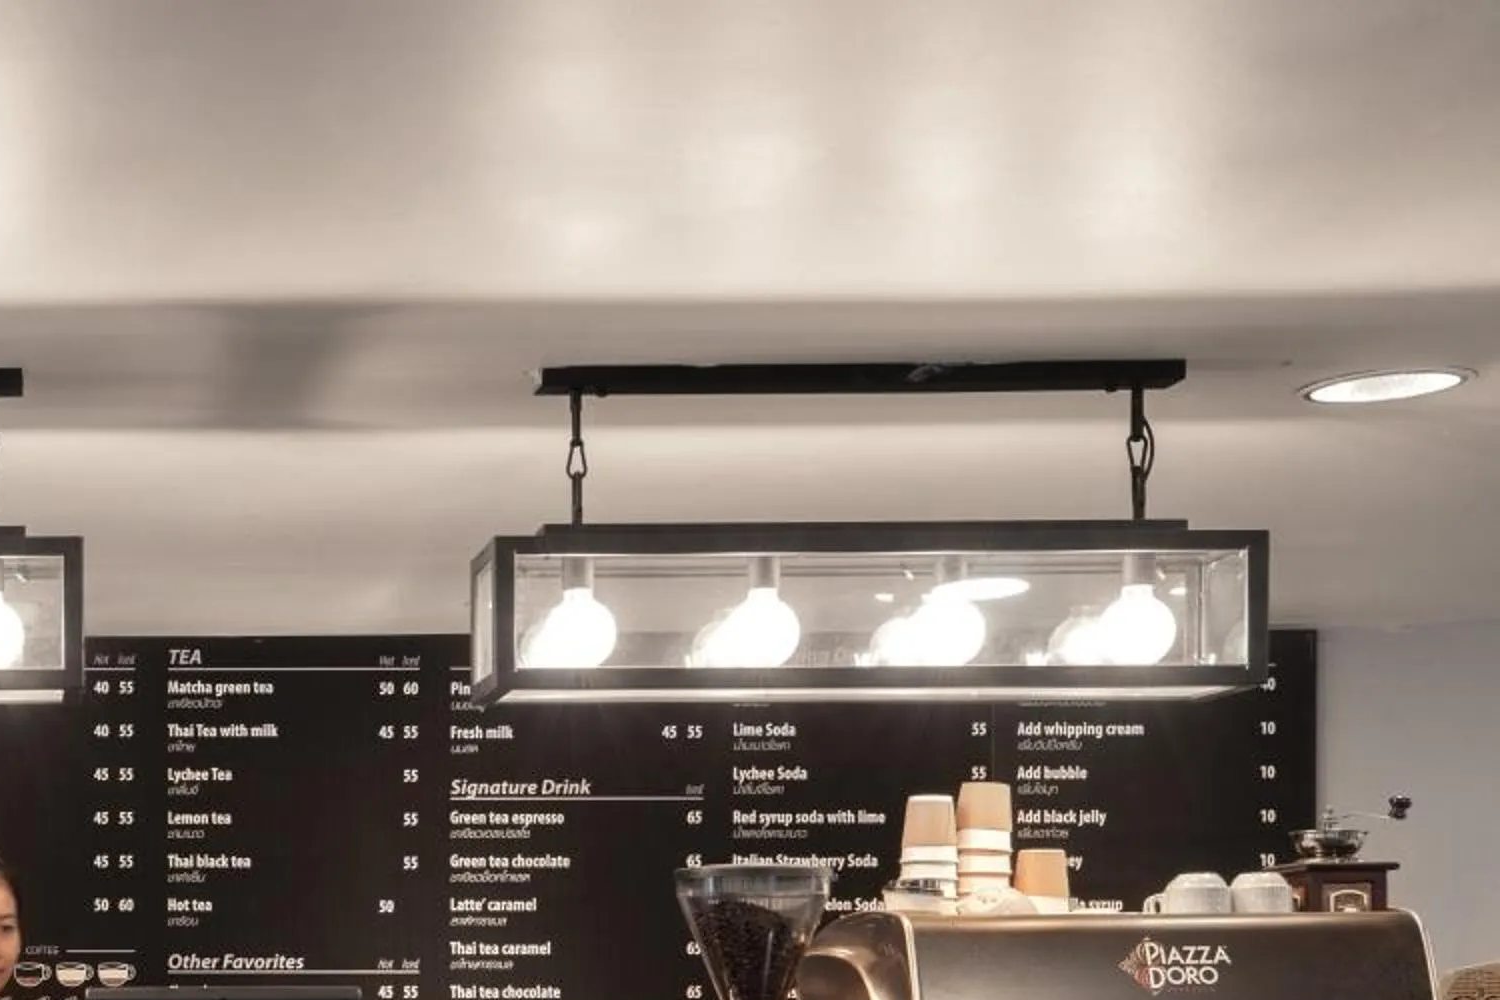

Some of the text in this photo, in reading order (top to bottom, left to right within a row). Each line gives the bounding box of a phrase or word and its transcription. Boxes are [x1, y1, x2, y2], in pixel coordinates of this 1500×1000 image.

[170, 649, 201, 664] TEA
[94, 681, 133, 694] 40 55
[168, 680, 273, 696] Matcha green tea
[380, 682, 418, 695] 50 60
[451, 682, 473, 695] Pin
[94, 724, 133, 737] 40 55
[168, 724, 278, 737] Thai Tea with milk
[379, 726, 418, 738] 45 55
[451, 725, 513, 739] Fresh milk
[662, 725, 702, 738] 45 55
[734, 723, 796, 736] Lime Soda
[972, 722, 986, 736] 55
[1018, 722, 1144, 738] Add whipping cream
[1261, 722, 1276, 734] 10
[94, 768, 133, 781] 45 55
[168, 768, 232, 783] Lychee Tea
[404, 769, 418, 782] 55
[733, 766, 807, 785] Lychee Soda
[972, 766, 986, 780] 55
[1017, 766, 1087, 779] Add bubble
[1260, 766, 1275, 778] 10
[450, 779, 592, 800] Signature Drink
[94, 812, 133, 824] 45 55
[168, 812, 231, 824] Lemon tea
[404, 813, 418, 826] 55
[450, 810, 564, 830] Green tea espresso
[687, 811, 702, 824] 65
[733, 810, 886, 829] Red syrup soda with lime
[1017, 810, 1106, 826] Add black jelly
[1260, 810, 1276, 822] 10
[94, 855, 133, 868] 45 55
[168, 854, 251, 868] Thai black tea
[404, 856, 418, 869] 55
[450, 854, 570, 868] Green tea chocolate
[686, 855, 702, 867] 65
[776, 854, 845, 870] Strawberry
[848, 854, 878, 867] Soda
[1261, 854, 1276, 866] 10
[94, 898, 134, 911] 50 60
[168, 899, 212, 911] Hot tea
[379, 900, 394, 912] 50
[488, 898, 537, 911] caramel
[450, 941, 551, 955] Thai tea caramel
[1144, 942, 1232, 966] PIAZZA
[168, 954, 304, 969] Other Favorites
[378, 986, 418, 998] 45 55
[450, 985, 560, 998] Thai tea chocolate
[687, 986, 702, 998] 65
